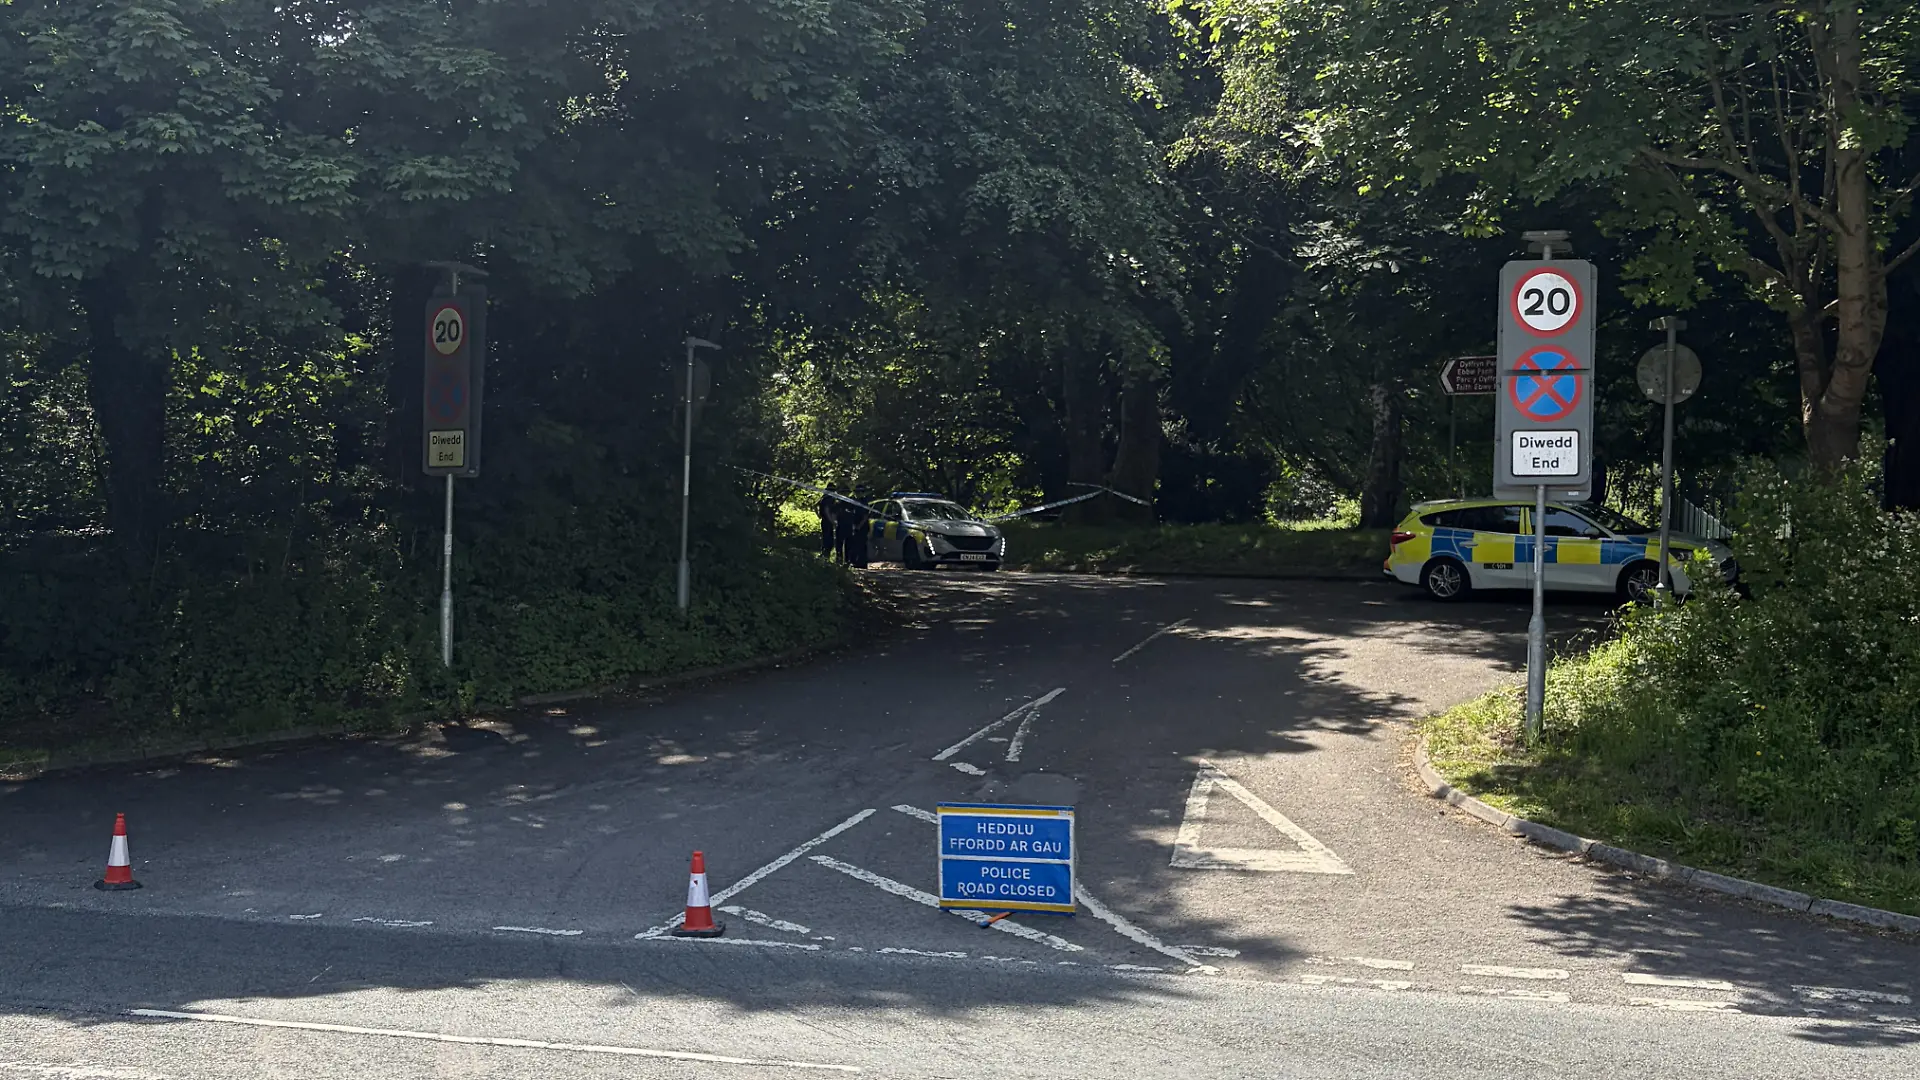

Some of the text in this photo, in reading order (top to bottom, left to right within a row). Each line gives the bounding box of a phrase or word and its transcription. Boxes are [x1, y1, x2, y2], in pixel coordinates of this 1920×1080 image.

[1524, 288, 1570, 316] 20
[436, 319, 460, 343] 20
[432, 435, 461, 445] Diwedd
[1519, 437, 1572, 448] Diwedd
[439, 452, 454, 461] End
[1532, 457, 1559, 468] End
[977, 822, 1034, 836] HEDDLU
[950, 838, 1062, 853] FFORDD AR GAU
[981, 867, 1031, 880] POLICE
[957, 882, 1056, 897] ROAD CLOSED
